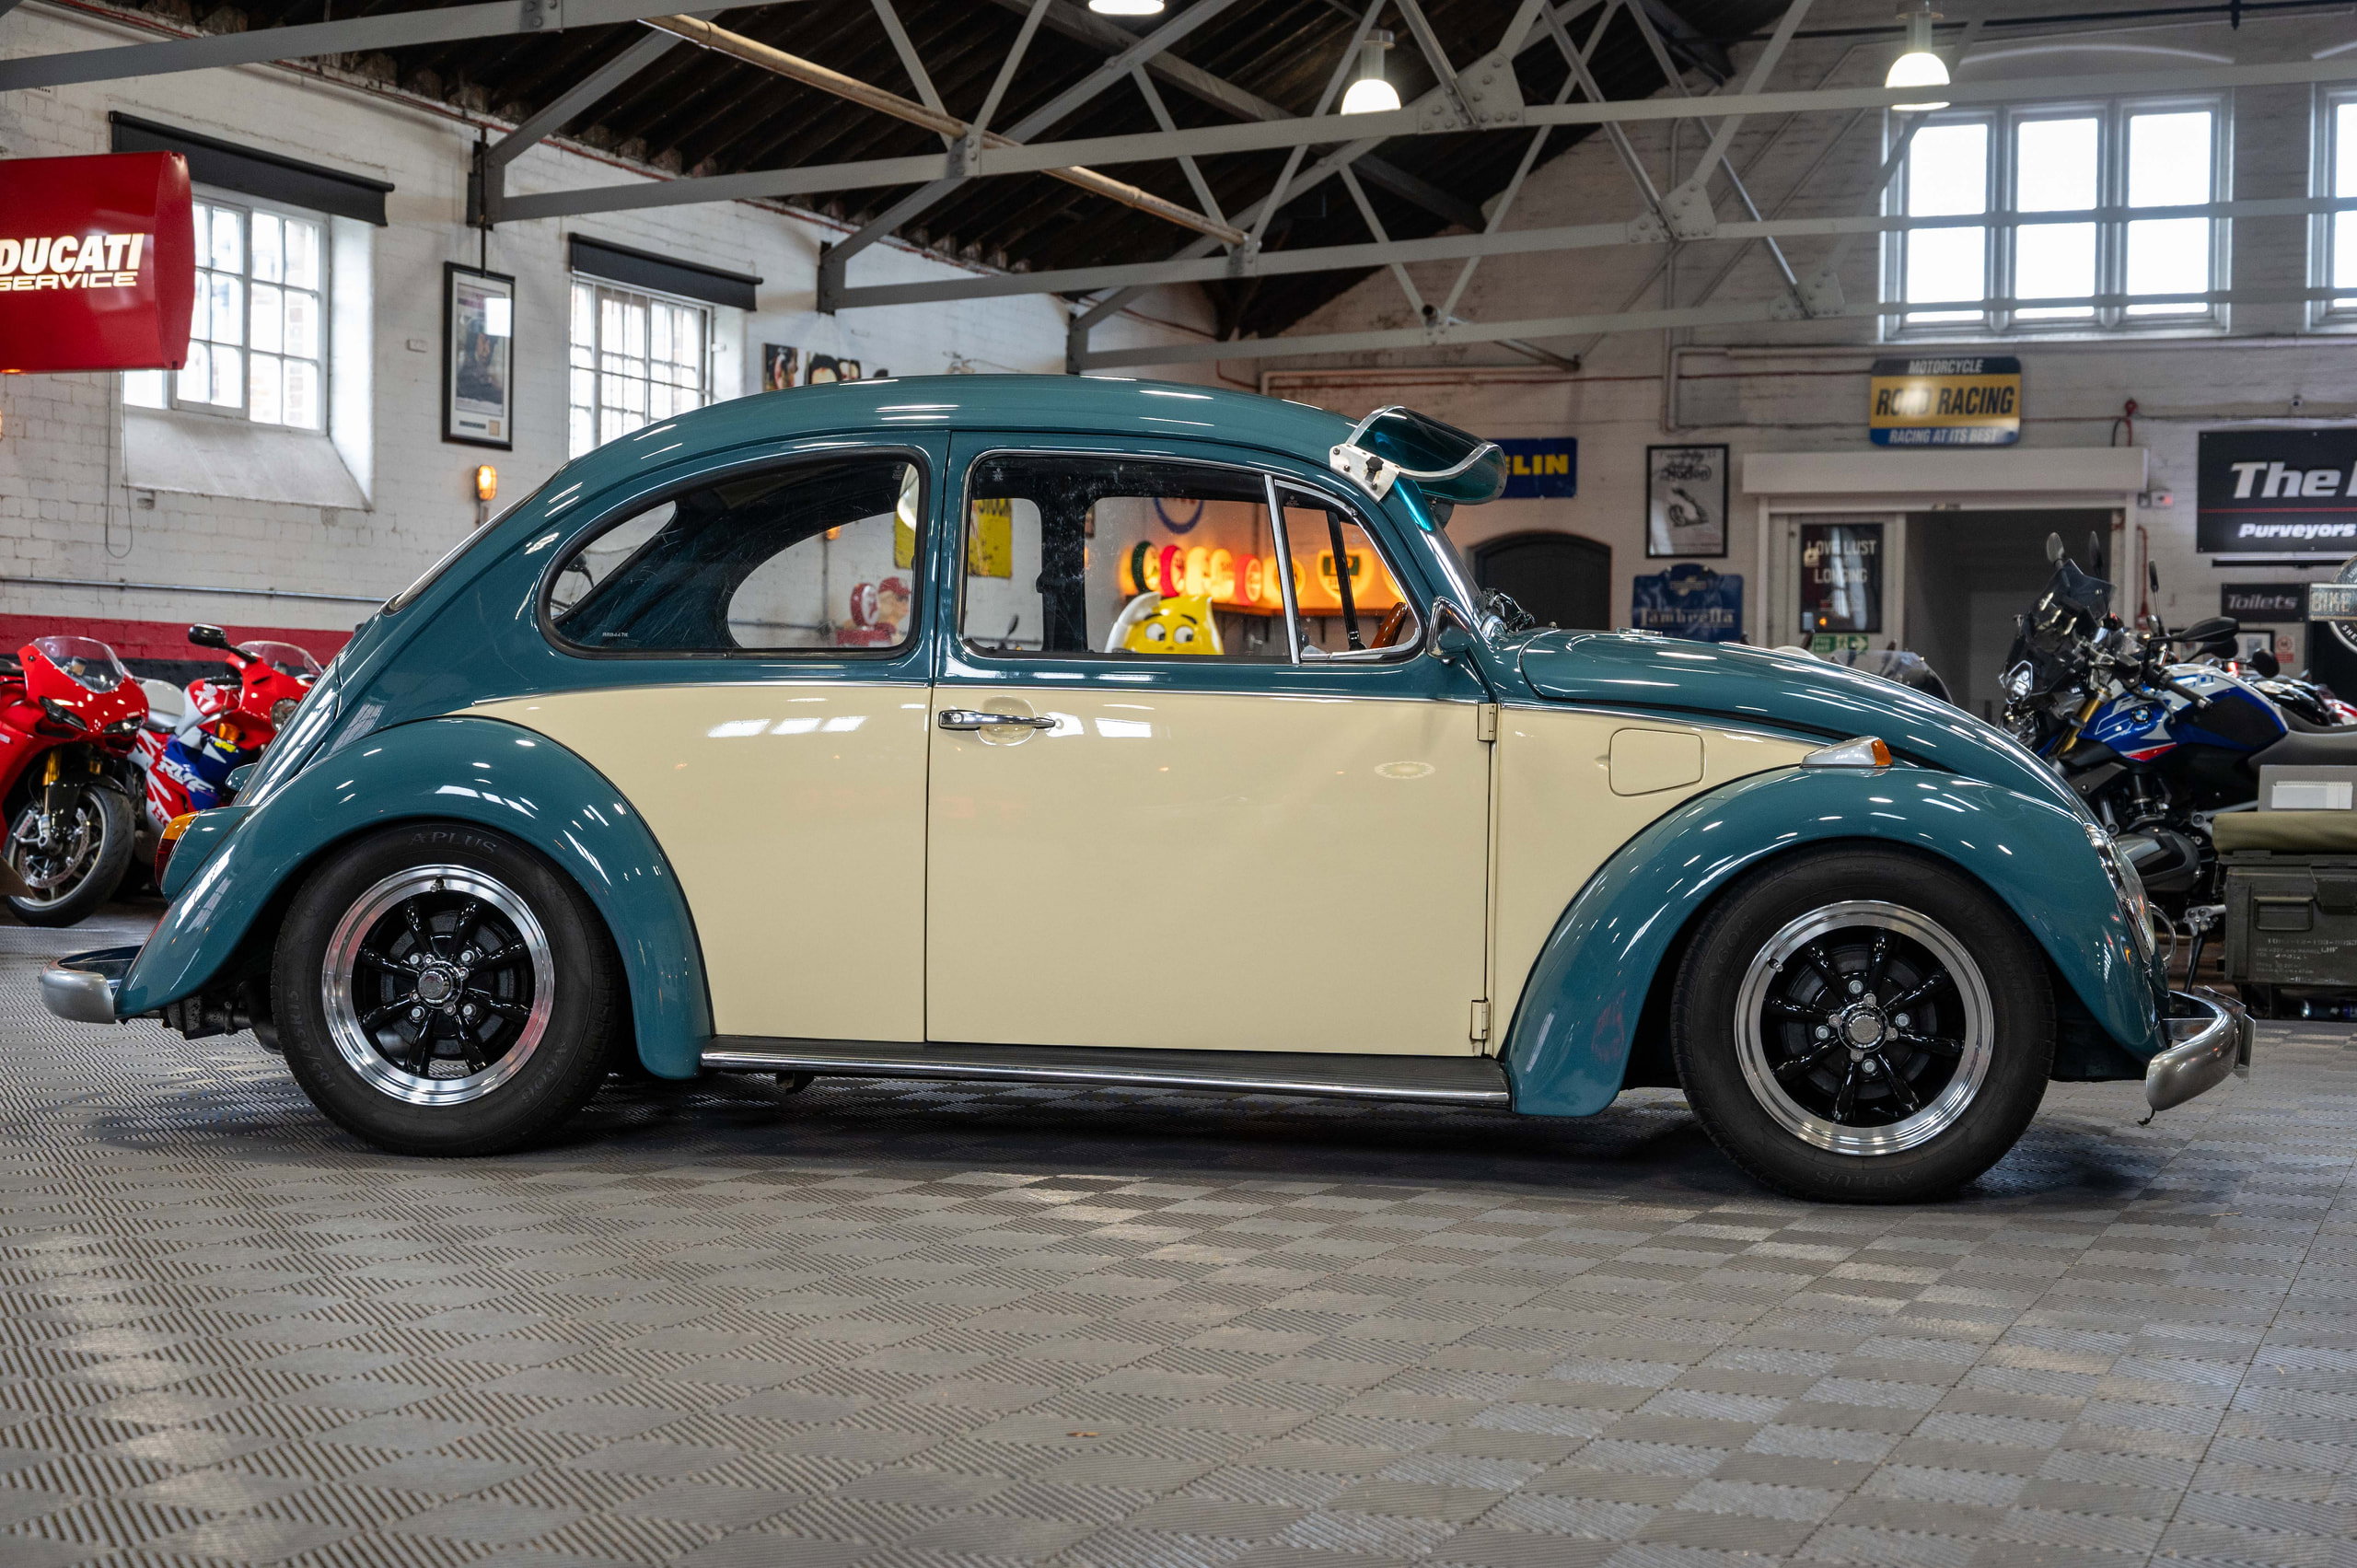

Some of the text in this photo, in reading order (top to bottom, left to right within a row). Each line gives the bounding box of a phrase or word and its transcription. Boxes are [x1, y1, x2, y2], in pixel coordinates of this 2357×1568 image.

[0, 233, 145, 275] DUCATI
[0, 271, 138, 292] SERVICE
[1908, 358, 1985, 375] MOTORCYCLE
[1875, 385, 2015, 416] ROD RACING
[1889, 427, 1997, 444] RACING AT ITS BEST
[2231, 461, 2342, 498] The
[2237, 523, 2357, 540] Purveyors
[1843, 540, 1877, 555] LUST
[2227, 593, 2299, 610] Toilets
[2311, 591, 2352, 612] BIKE
[408, 830, 498, 854] APLUS
